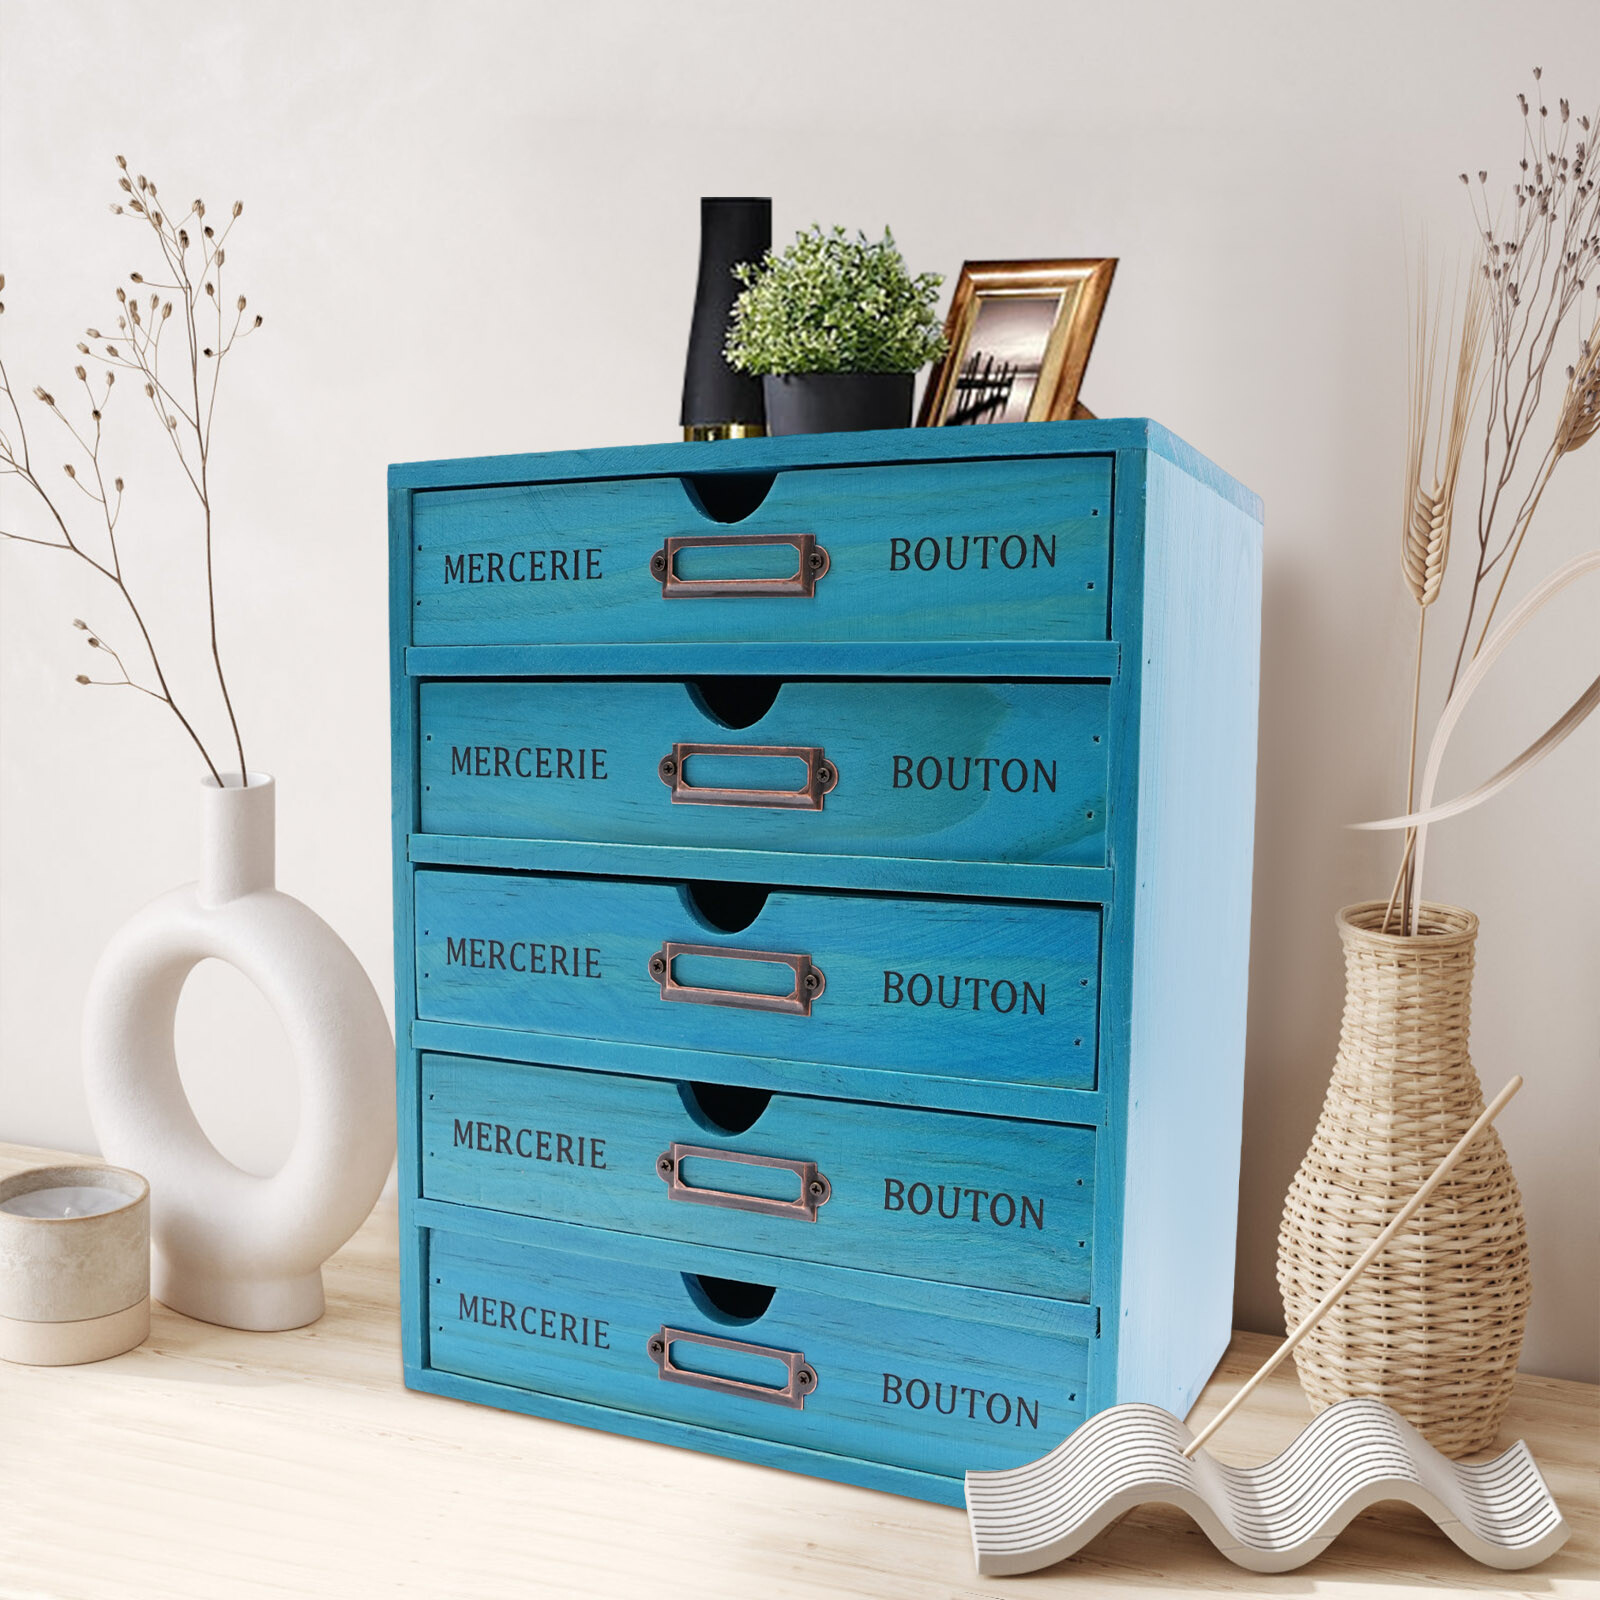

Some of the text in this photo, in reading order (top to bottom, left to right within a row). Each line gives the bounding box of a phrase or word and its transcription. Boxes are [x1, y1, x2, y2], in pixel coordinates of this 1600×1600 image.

[445, 533, 1057, 584] MERCERIE BOUTON
[451, 746, 1057, 793] MERCERIE BOUTON
[447, 937, 1046, 1016] MERCERIE BOUTON
[454, 1119, 1044, 1231] MERCERIE BOUTON
[459, 1294, 1039, 1430] MERCERIE BOUTON
